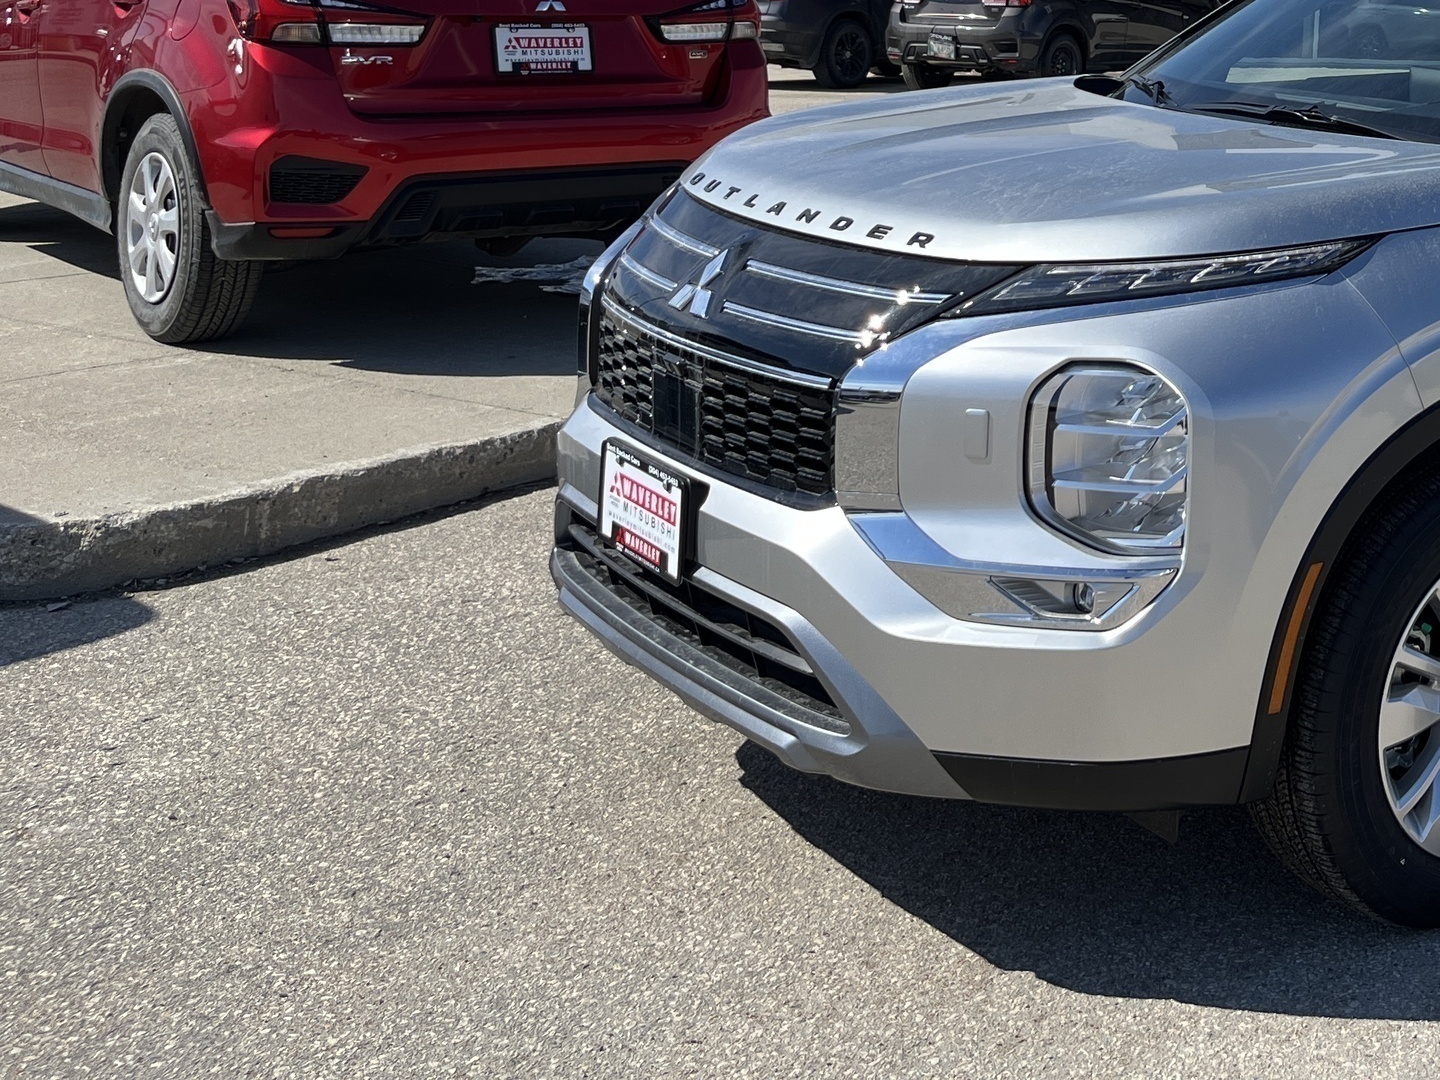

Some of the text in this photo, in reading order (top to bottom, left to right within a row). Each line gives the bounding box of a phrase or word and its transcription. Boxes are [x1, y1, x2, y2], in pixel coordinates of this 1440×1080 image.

[519, 38, 582, 47] WAVERLEY
[690, 172, 935, 248] OUTLANDER
[622, 476, 677, 523] WAVERLEY
[622, 500, 676, 541] MITSUBISHI
[624, 530, 660, 563] WAVERLEY
